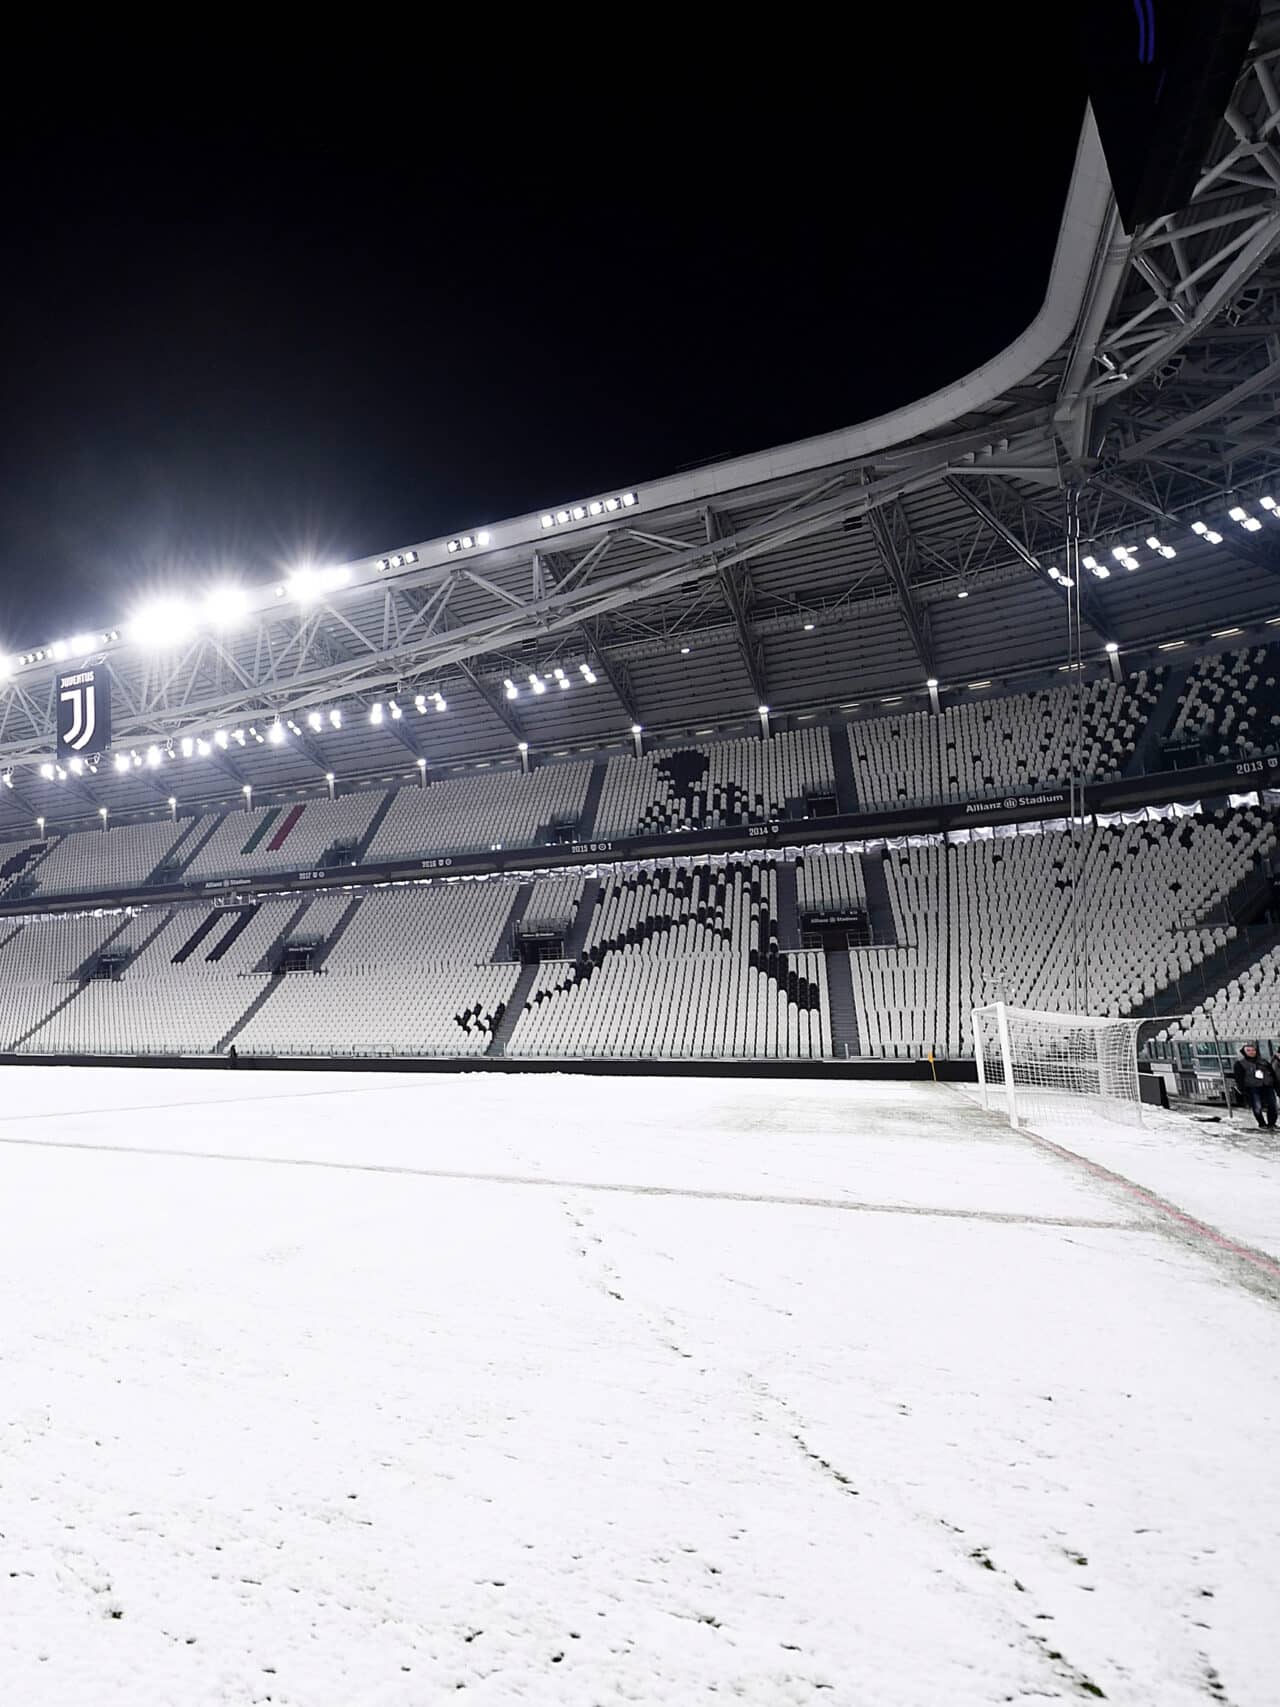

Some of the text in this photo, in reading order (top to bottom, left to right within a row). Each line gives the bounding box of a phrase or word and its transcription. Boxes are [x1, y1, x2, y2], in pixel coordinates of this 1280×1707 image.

[60, 671, 95, 689] JUVENTUS
[1236, 760, 1264, 775] 2013
[966, 794, 1064, 814] Allianz Stadium
[748, 826, 769, 837] 2014
